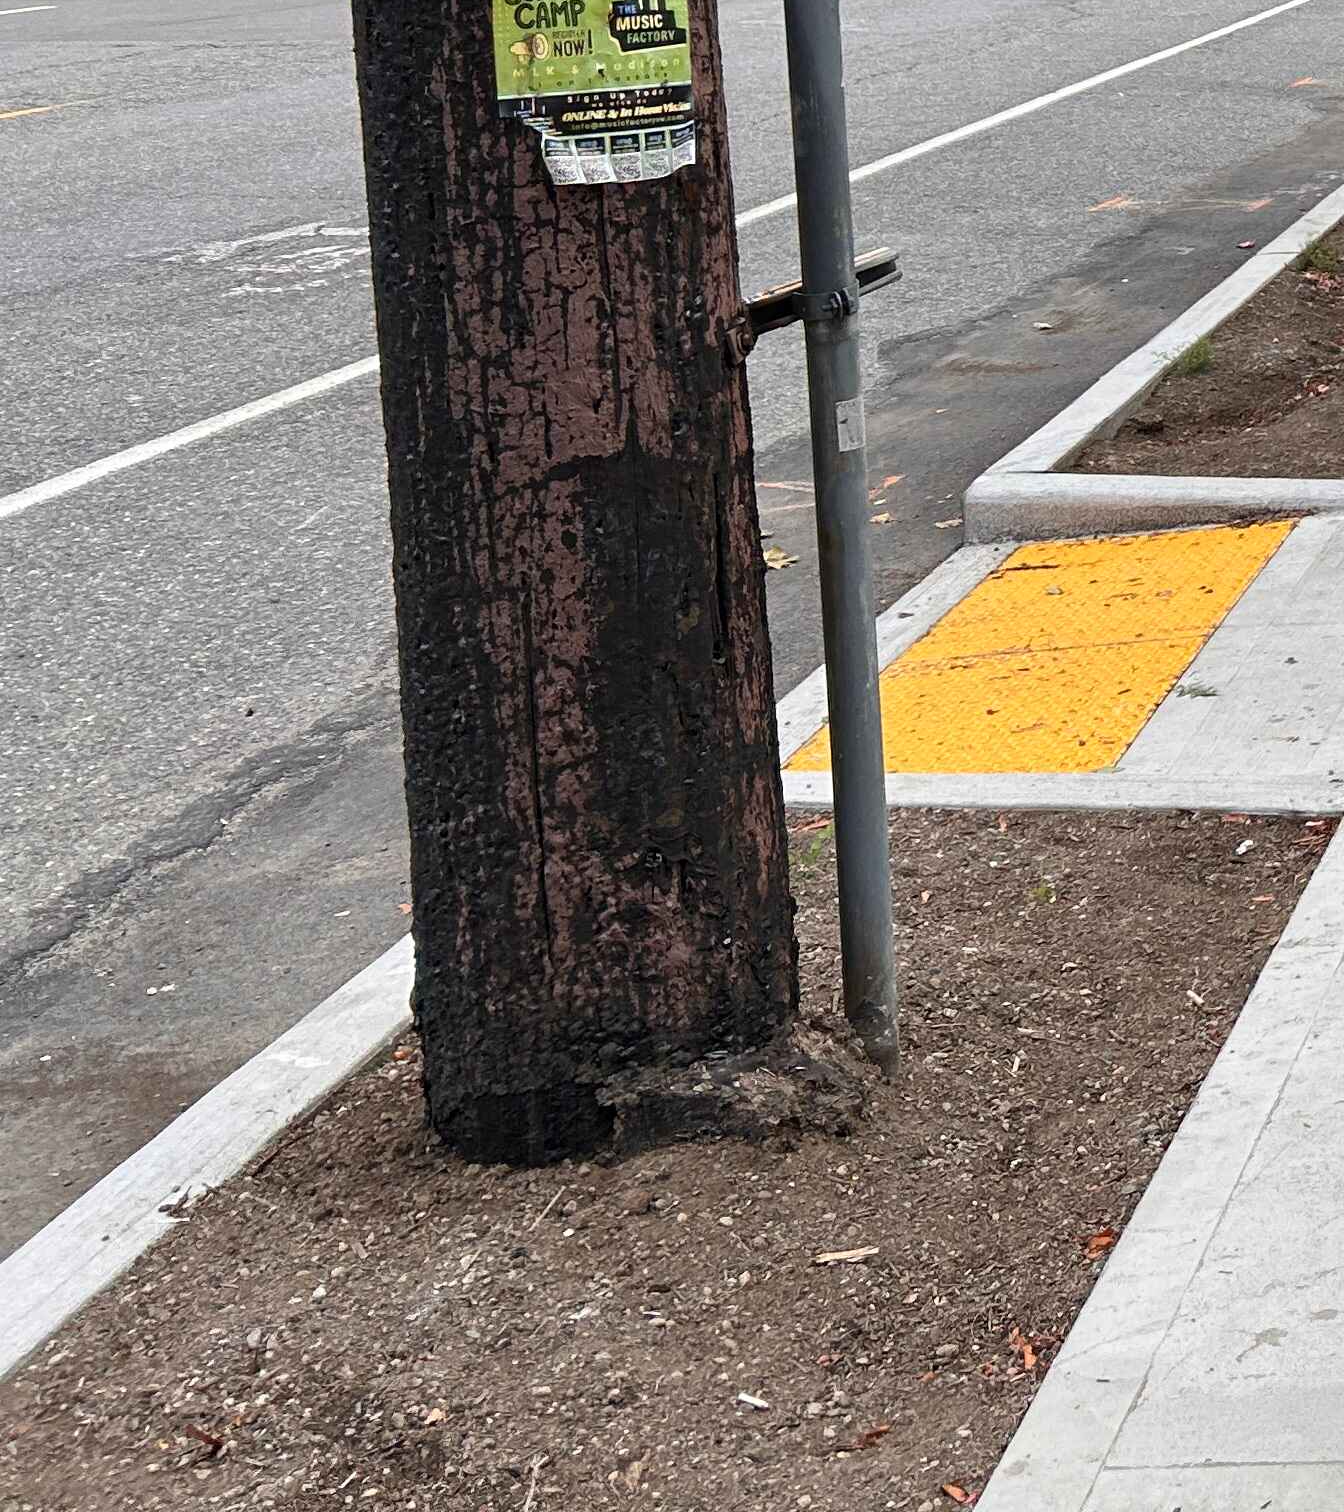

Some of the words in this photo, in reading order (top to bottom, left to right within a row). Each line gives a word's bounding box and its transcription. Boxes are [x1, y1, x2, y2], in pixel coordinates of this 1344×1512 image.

[514, 0, 586, 29] CAMP
[617, 5, 637, 15] THE
[616, 14, 664, 31] MUSIC
[626, 30, 676, 44] FACTORY
[561, 109, 608, 122] ONLINE
